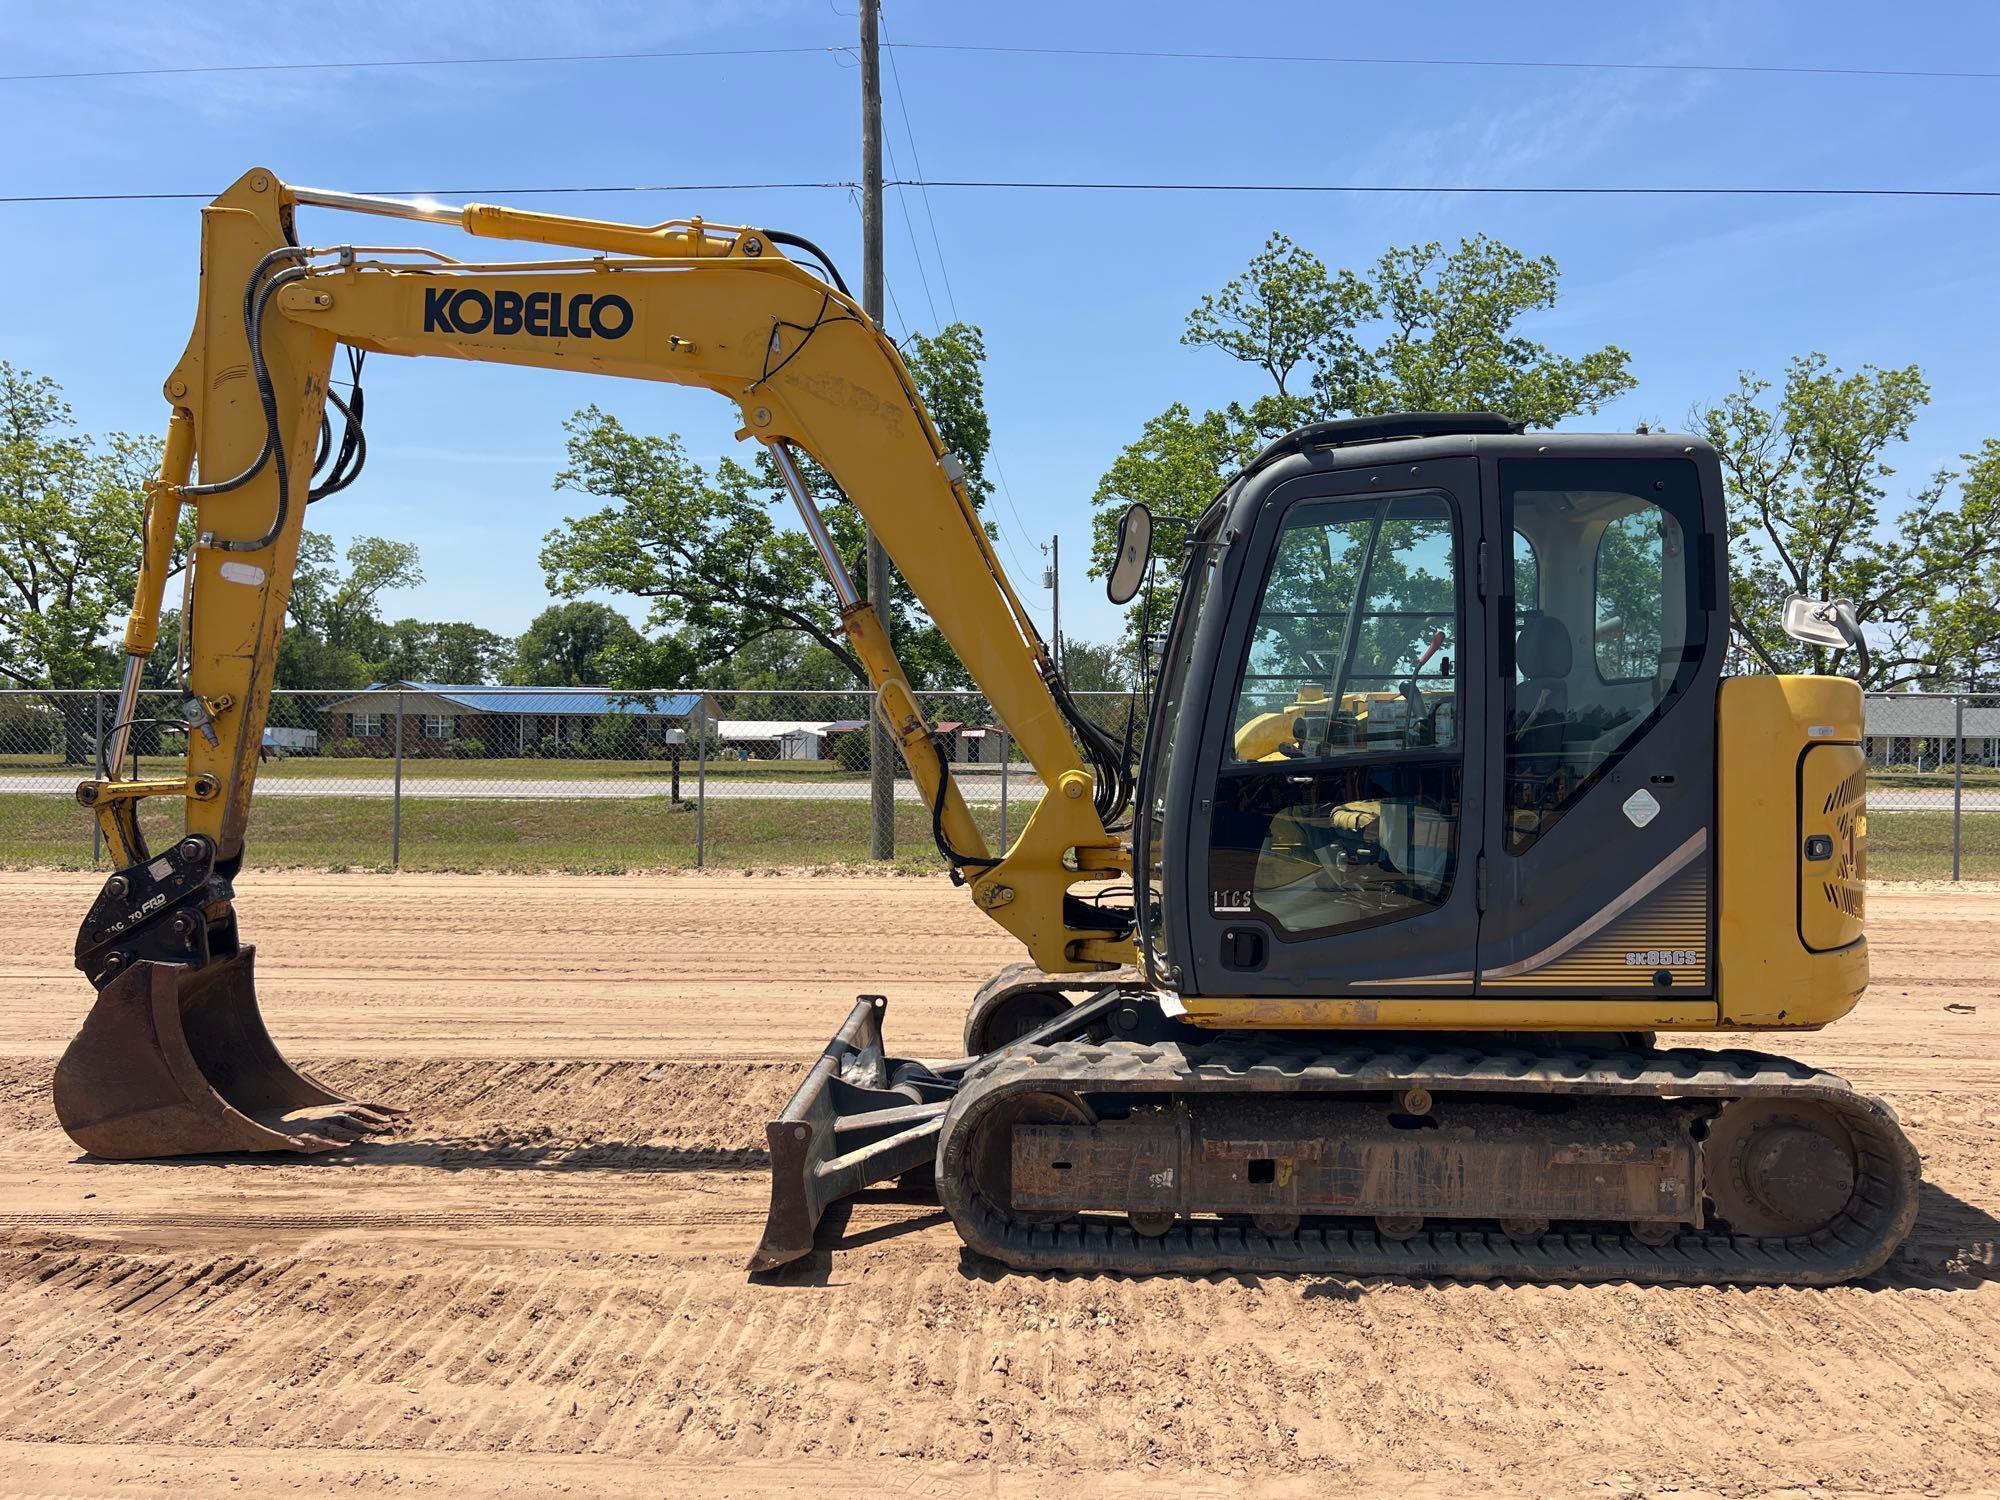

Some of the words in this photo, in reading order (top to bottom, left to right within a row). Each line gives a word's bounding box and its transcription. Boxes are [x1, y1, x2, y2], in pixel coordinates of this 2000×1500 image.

[424, 288, 633, 339] KOBELCO
[128, 910, 142, 922] 70
[141, 893, 166, 913] FRD
[1214, 890, 1251, 906] ITCS
[1625, 950, 1697, 965] SK85CS
